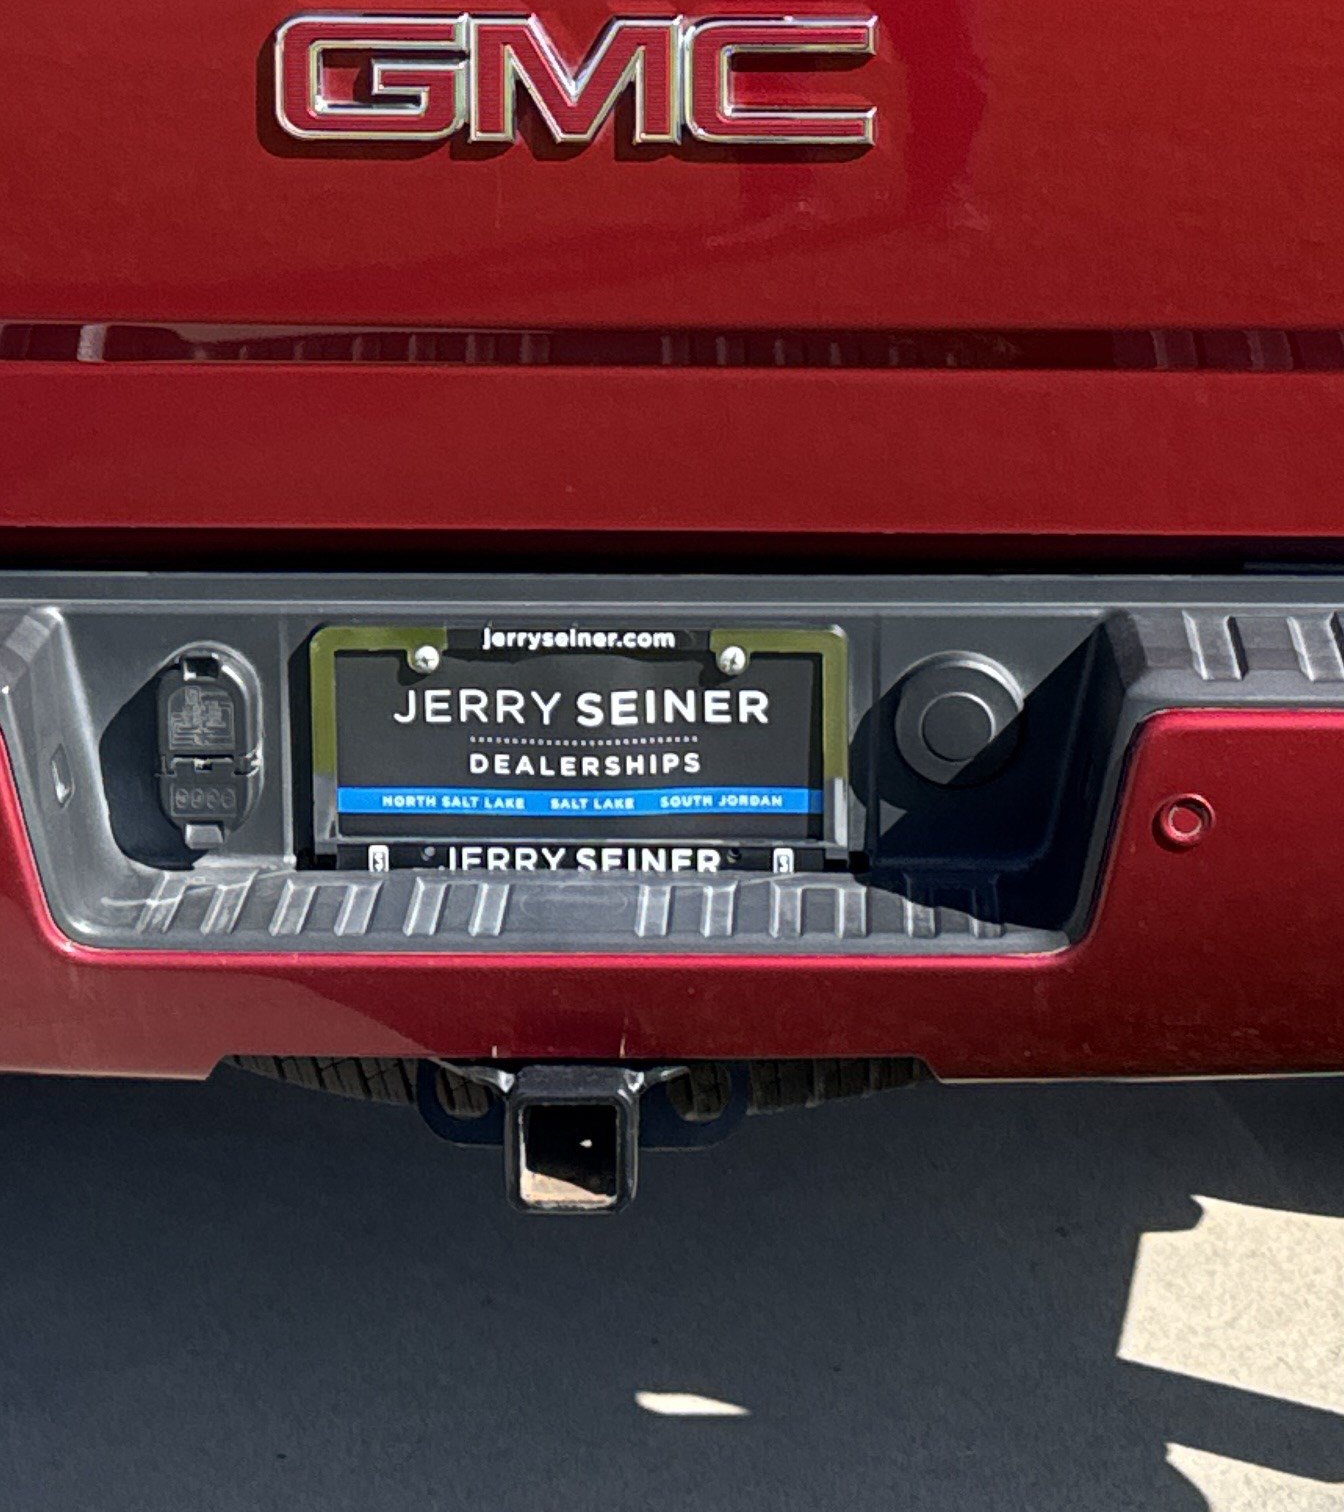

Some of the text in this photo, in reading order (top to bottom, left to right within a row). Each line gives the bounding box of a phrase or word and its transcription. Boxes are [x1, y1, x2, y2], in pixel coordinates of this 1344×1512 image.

[273, 11, 880, 147] GMC
[481, 626, 676, 651] jerryseiner.com
[392, 688, 771, 727] JERRY SEINER
[468, 751, 702, 777] DEALERSHIPS
[382, 795, 526, 810] NORTH SALT LAKE
[549, 796, 636, 810] SALT LAKE
[659, 794, 784, 809] SOUTH JORDAN
[574, 847, 722, 873] SEINER
